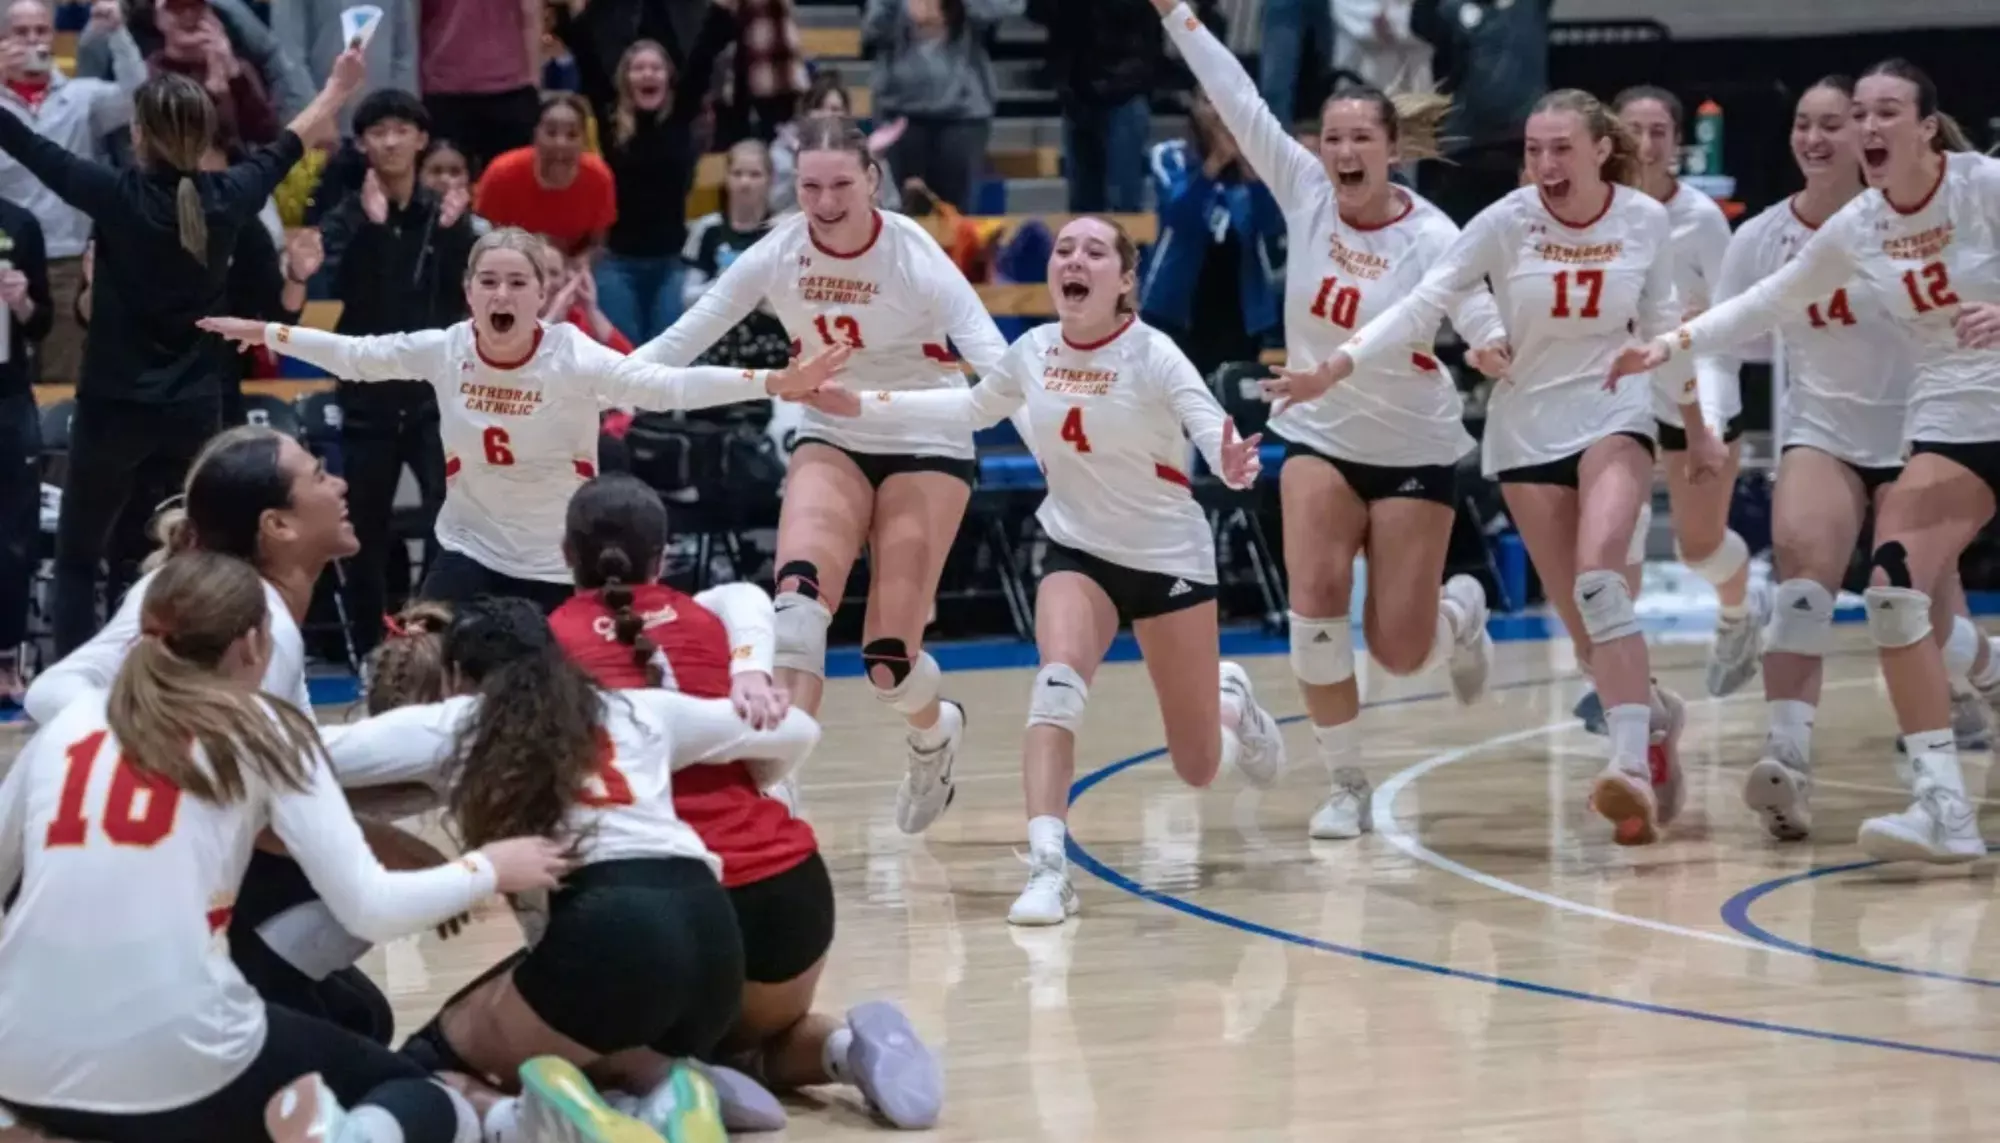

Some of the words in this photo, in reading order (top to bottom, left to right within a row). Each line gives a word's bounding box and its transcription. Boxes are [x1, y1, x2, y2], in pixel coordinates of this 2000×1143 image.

[1328, 232, 1391, 270] CHEDRAL
[1309, 275, 1362, 330] 10
[1550, 269, 1606, 319] 17
[1806, 286, 1858, 328] 14
[1902, 261, 1959, 313] 12
[812, 313, 866, 349] 13
[460, 382, 543, 403] CATHEDRAL
[465, 397, 535, 416] CATHOLIC
[483, 425, 515, 466] 6
[1060, 405, 1092, 454] 4
